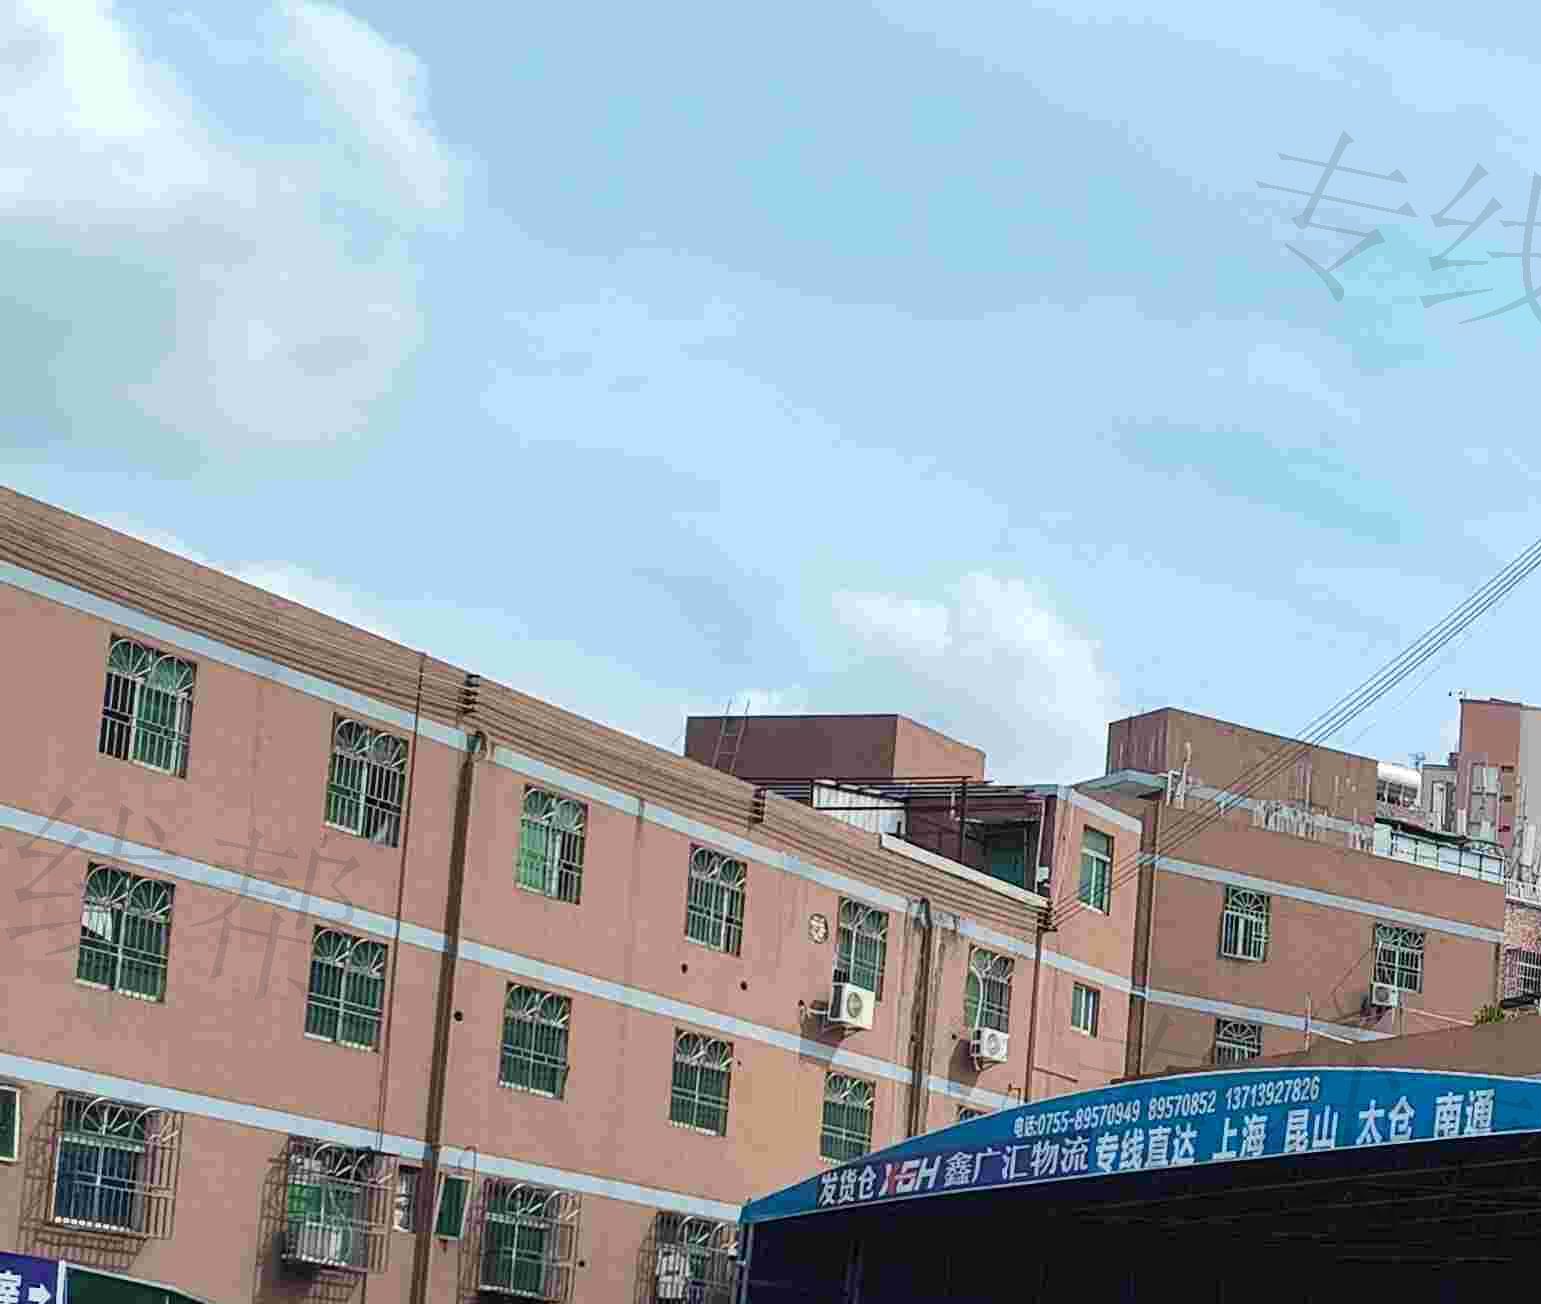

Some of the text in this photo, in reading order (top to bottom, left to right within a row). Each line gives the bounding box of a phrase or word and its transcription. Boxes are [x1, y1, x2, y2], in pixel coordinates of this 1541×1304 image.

[1147, 1091, 1216, 1121] 89570852
[1225, 1075, 1321, 1111] 13713927826
[818, 1167, 878, 1207] 发货仓
[944, 1136, 1089, 1188] 鑫广汇物流
[1095, 1118, 1199, 1173] 专线直达
[1212, 1112, 1268, 1161] 上海
[1284, 1104, 1339, 1151] 昆山
[1355, 1095, 1415, 1145] 太仓
[1433, 1088, 1496, 1137] 南通
